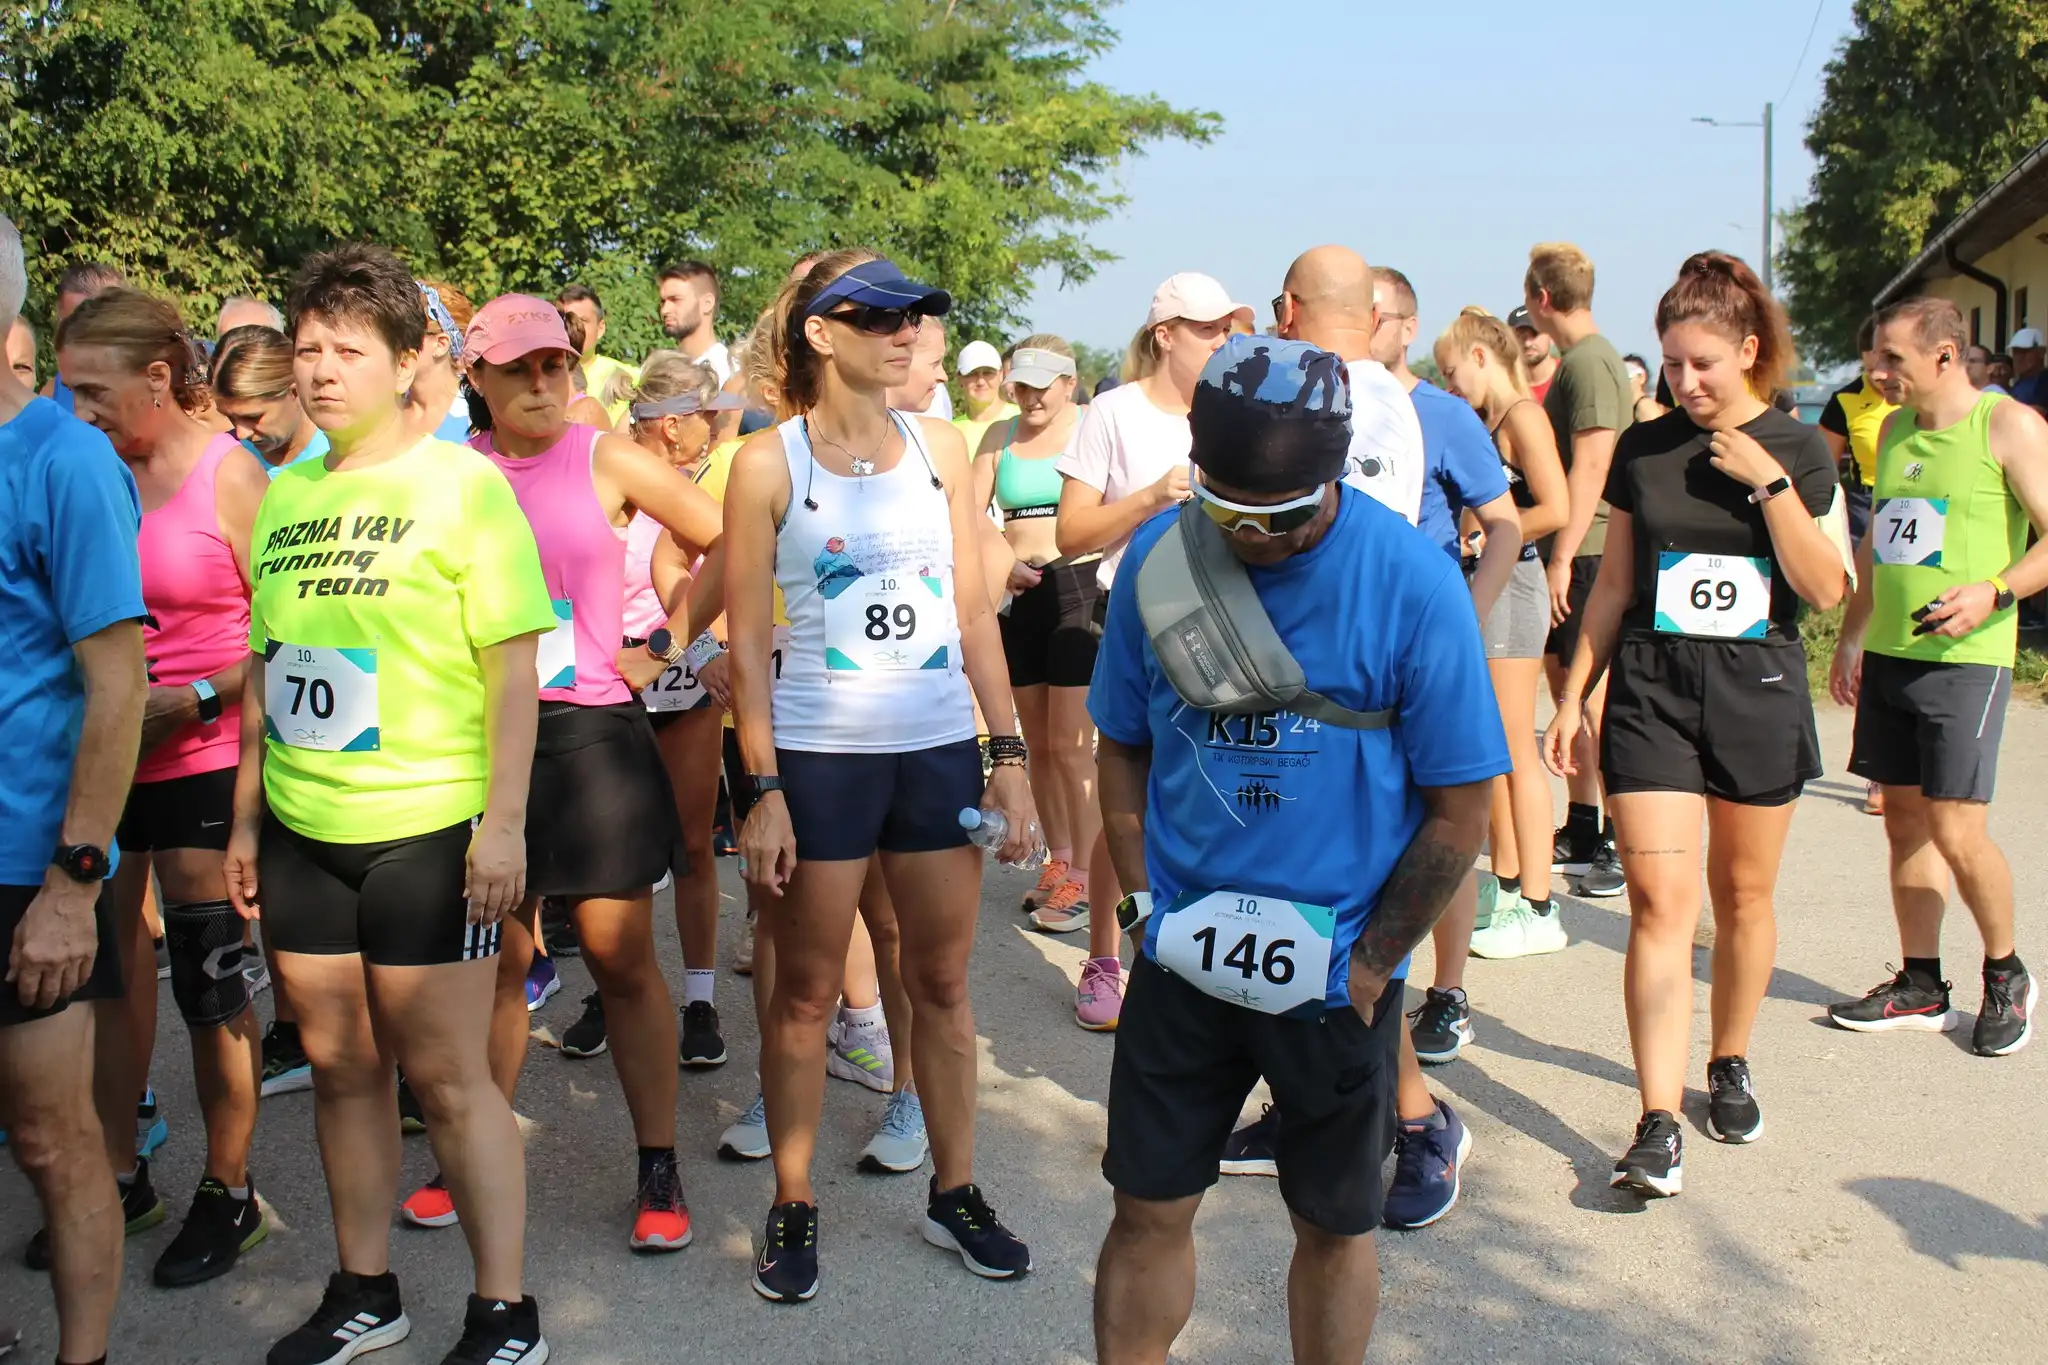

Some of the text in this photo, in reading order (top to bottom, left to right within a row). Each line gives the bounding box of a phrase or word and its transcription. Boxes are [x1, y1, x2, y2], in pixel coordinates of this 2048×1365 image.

[1016, 506, 1055, 517] TRAINING
[262, 515, 415, 556] PRIZMA V&V
[1888, 518, 1918, 544] 74
[880, 578, 900, 591] 10.
[1690, 579, 1737, 611] 69
[865, 603, 917, 641] 89
[298, 649, 315, 663] 10.
[286, 674, 335, 720] 70
[1208, 711, 1281, 748] K15
[1235, 898, 1262, 916] 10.
[1192, 926, 1296, 986] 146
